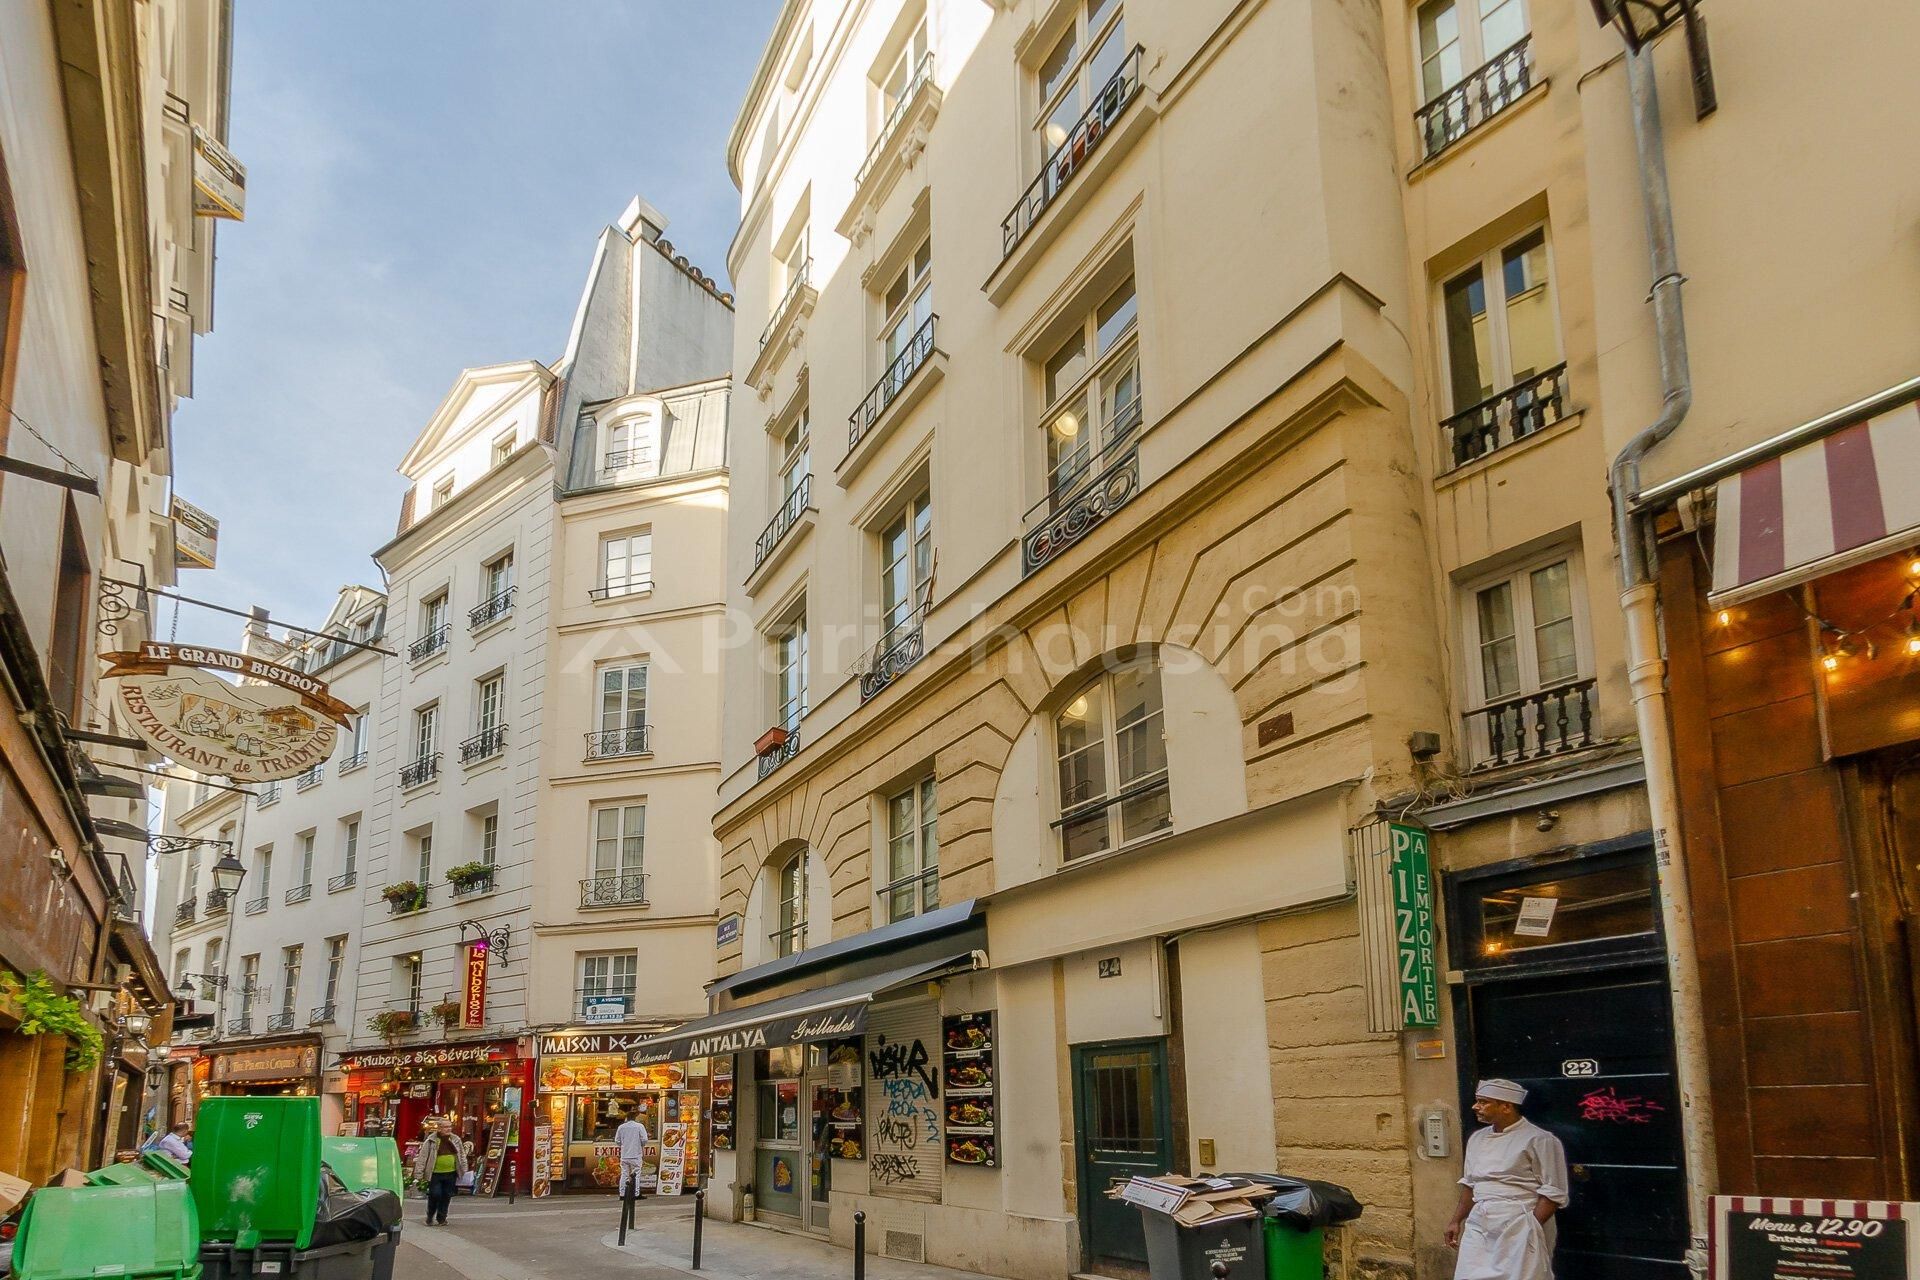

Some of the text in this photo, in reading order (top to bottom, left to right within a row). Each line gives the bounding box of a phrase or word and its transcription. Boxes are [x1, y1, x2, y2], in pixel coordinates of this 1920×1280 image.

[183, 504, 218, 526] VENDRE
[147, 645, 323, 695] LE GRAND BISTROT
[120, 683, 337, 774] RESTAURANT de TRADITION
[1391, 829, 1424, 1024] PIZZA
[1414, 838, 1437, 1020] A EMPORTER
[1100, 958, 1120, 977] 24
[791, 1015, 856, 1041] Grillades
[543, 1036, 601, 1053] MAISON
[608, 1035, 628, 1051] DE
[688, 1028, 767, 1057] ANTALYA
[353, 1054, 412, 1067] L'Auberge
[630, 1049, 673, 1066] Restaurant
[1566, 1061, 1593, 1075] 22
[1748, 1217, 1884, 1238] Menu à 12.90
[1768, 1233, 1818, 1246] Entrées
